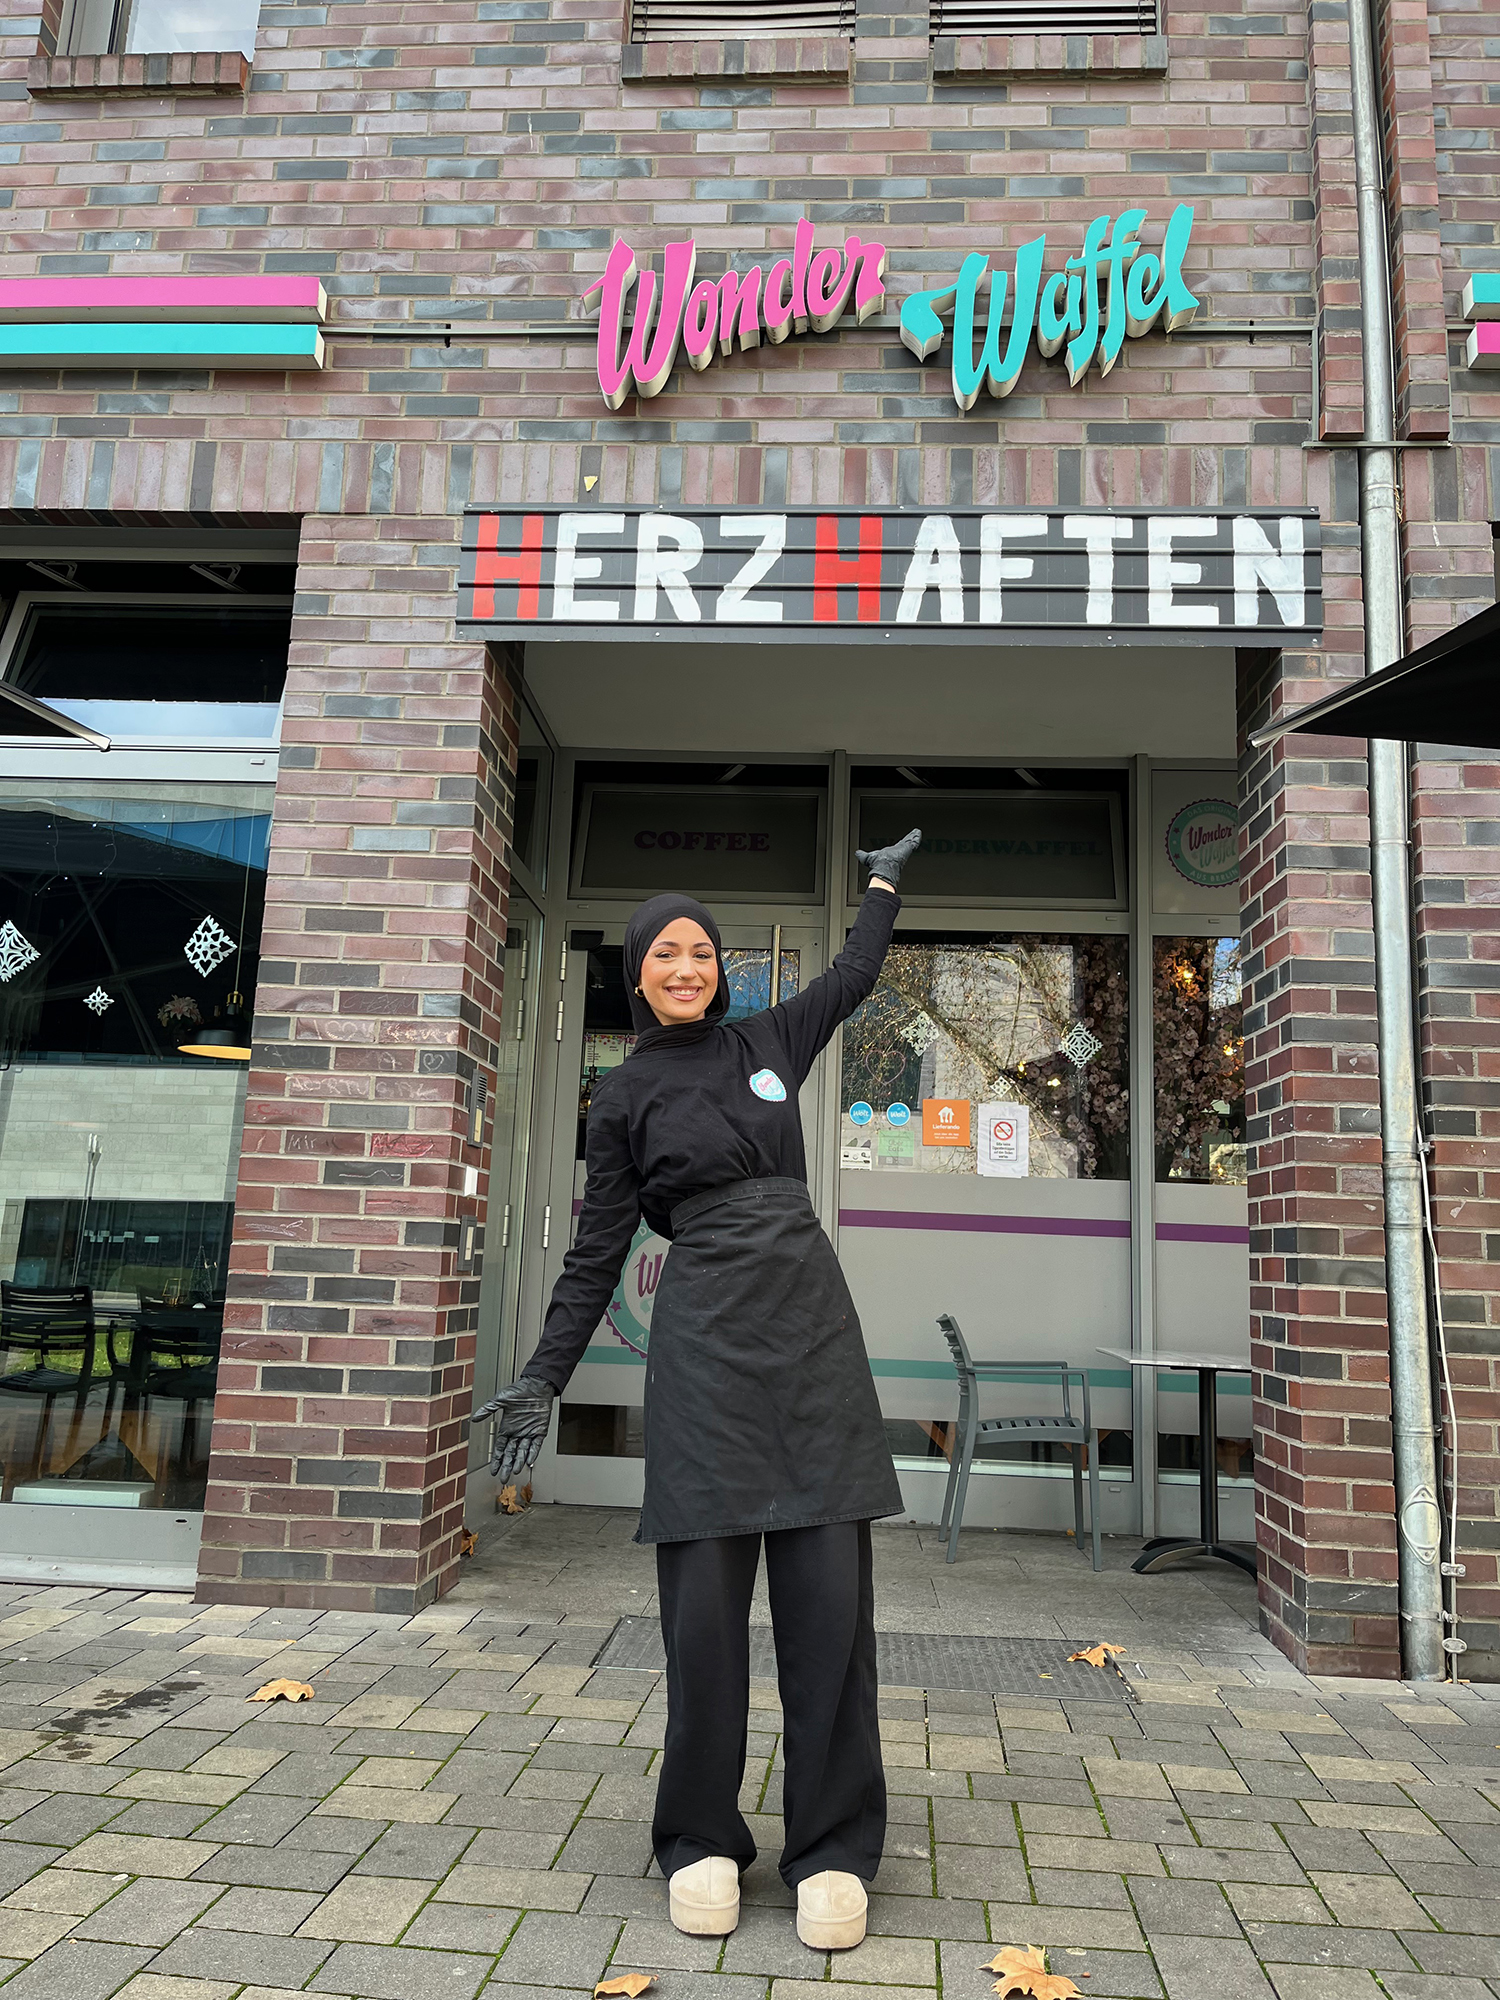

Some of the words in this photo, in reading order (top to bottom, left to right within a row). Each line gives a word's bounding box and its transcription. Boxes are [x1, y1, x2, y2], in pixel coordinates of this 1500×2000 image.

[581, 216, 887, 409] Wonder
[900, 203, 1200, 411] Waffel
[472, 514, 1306, 627] HERZHAFTEN
[1187, 807, 1202, 817] DAS
[1204, 805, 1238, 820] ORIGINA
[634, 830, 770, 852] COFFEE
[1187, 823, 1232, 851] Wonder
[1190, 839, 1236, 868] Waffel
[1190, 870, 1207, 881] AUS
[1210, 869, 1238, 881] BERLIN
